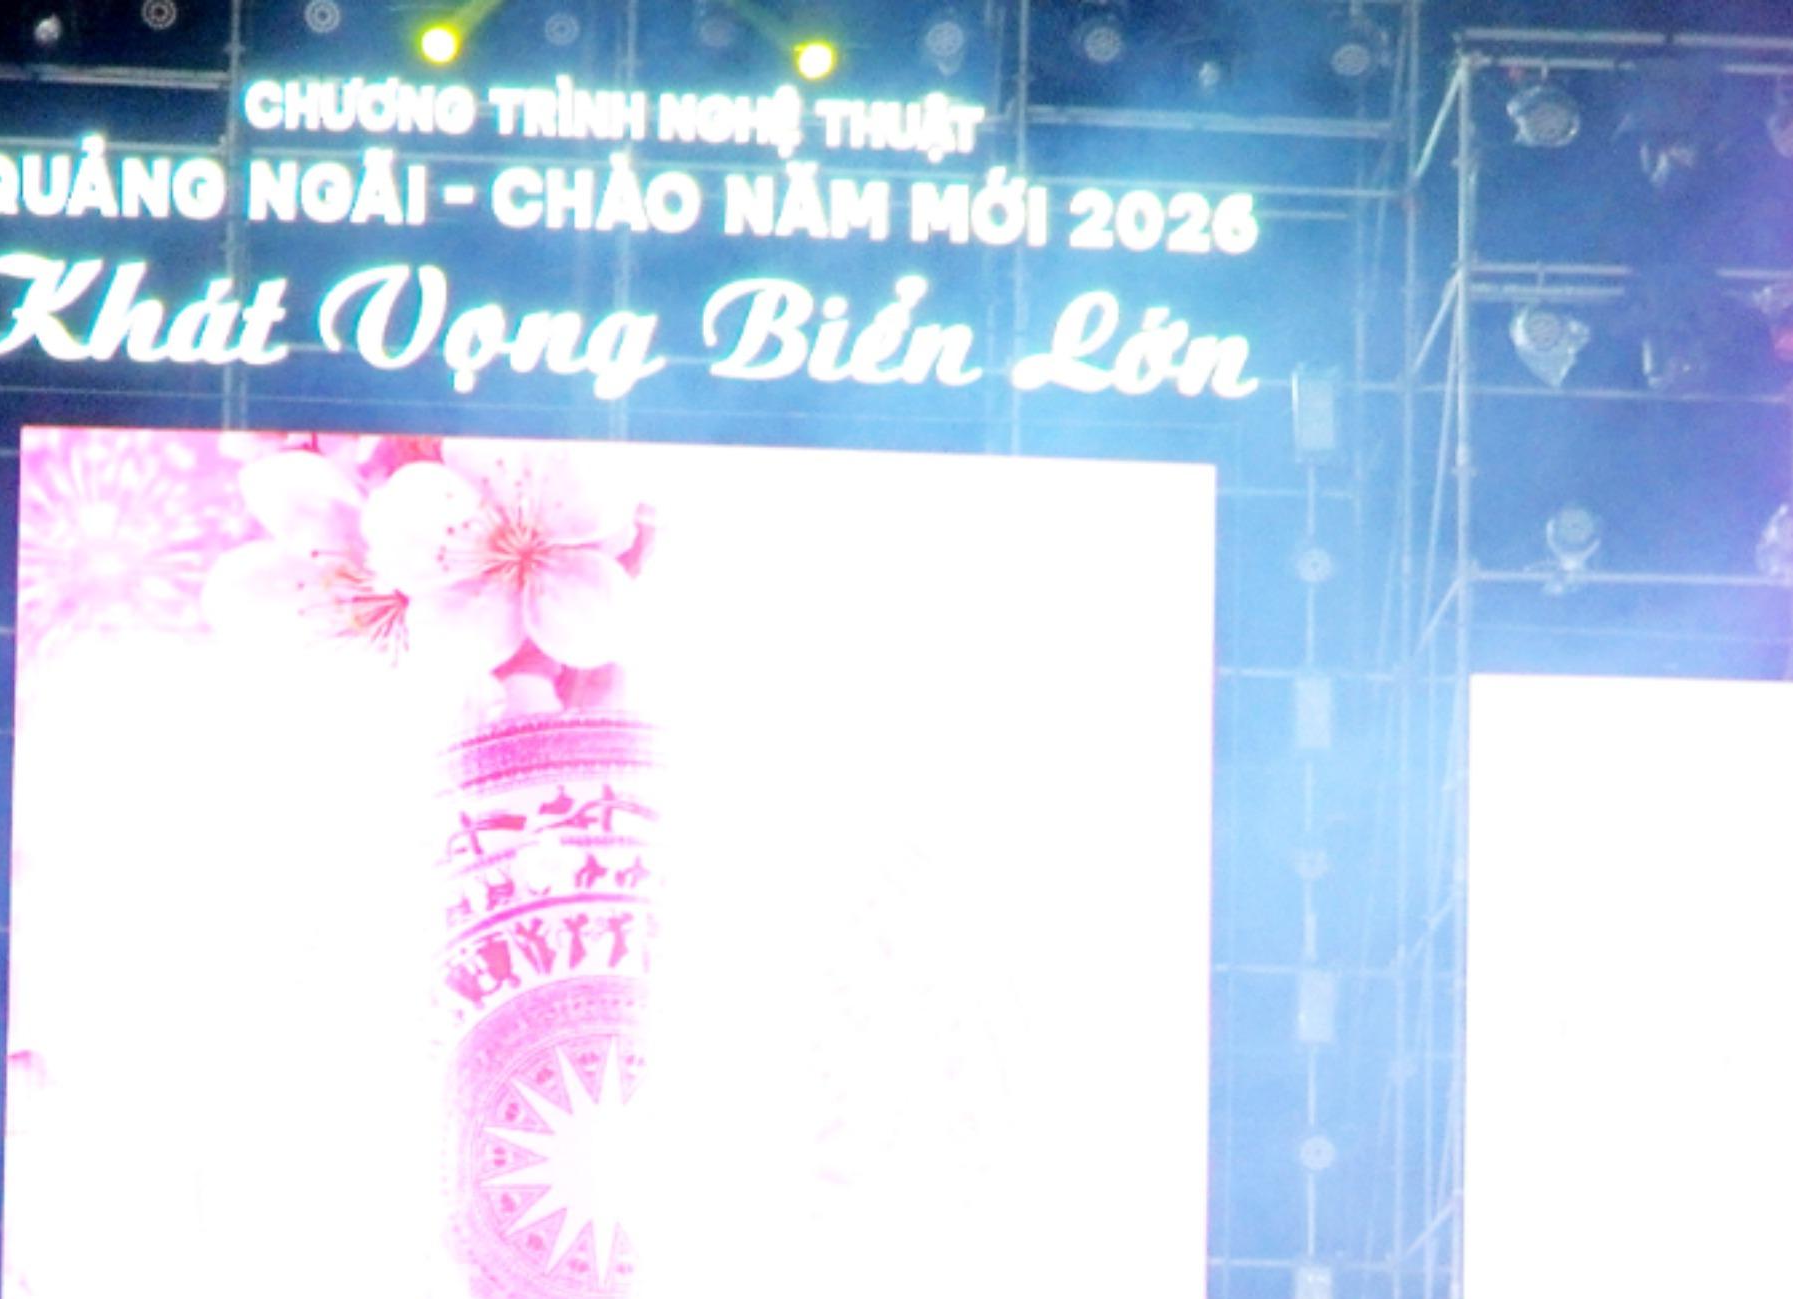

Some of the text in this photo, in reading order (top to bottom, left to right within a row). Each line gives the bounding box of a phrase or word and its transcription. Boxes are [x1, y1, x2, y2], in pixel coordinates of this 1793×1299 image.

[244, 74, 986, 164] CHƯƠNG TRÌNH NGHỆ THUẬT
[248, 147, 428, 226] NGÃI
[444, 186, 475, 205] -
[488, 152, 702, 234] CHÀO
[723, 162, 890, 242] NĂM
[910, 166, 1048, 249] MỚI
[1068, 188, 1260, 255] 2026
[318, 264, 668, 401] Vọng
[701, 275, 983, 388] Biển
[1010, 289, 1260, 400] Lớn
